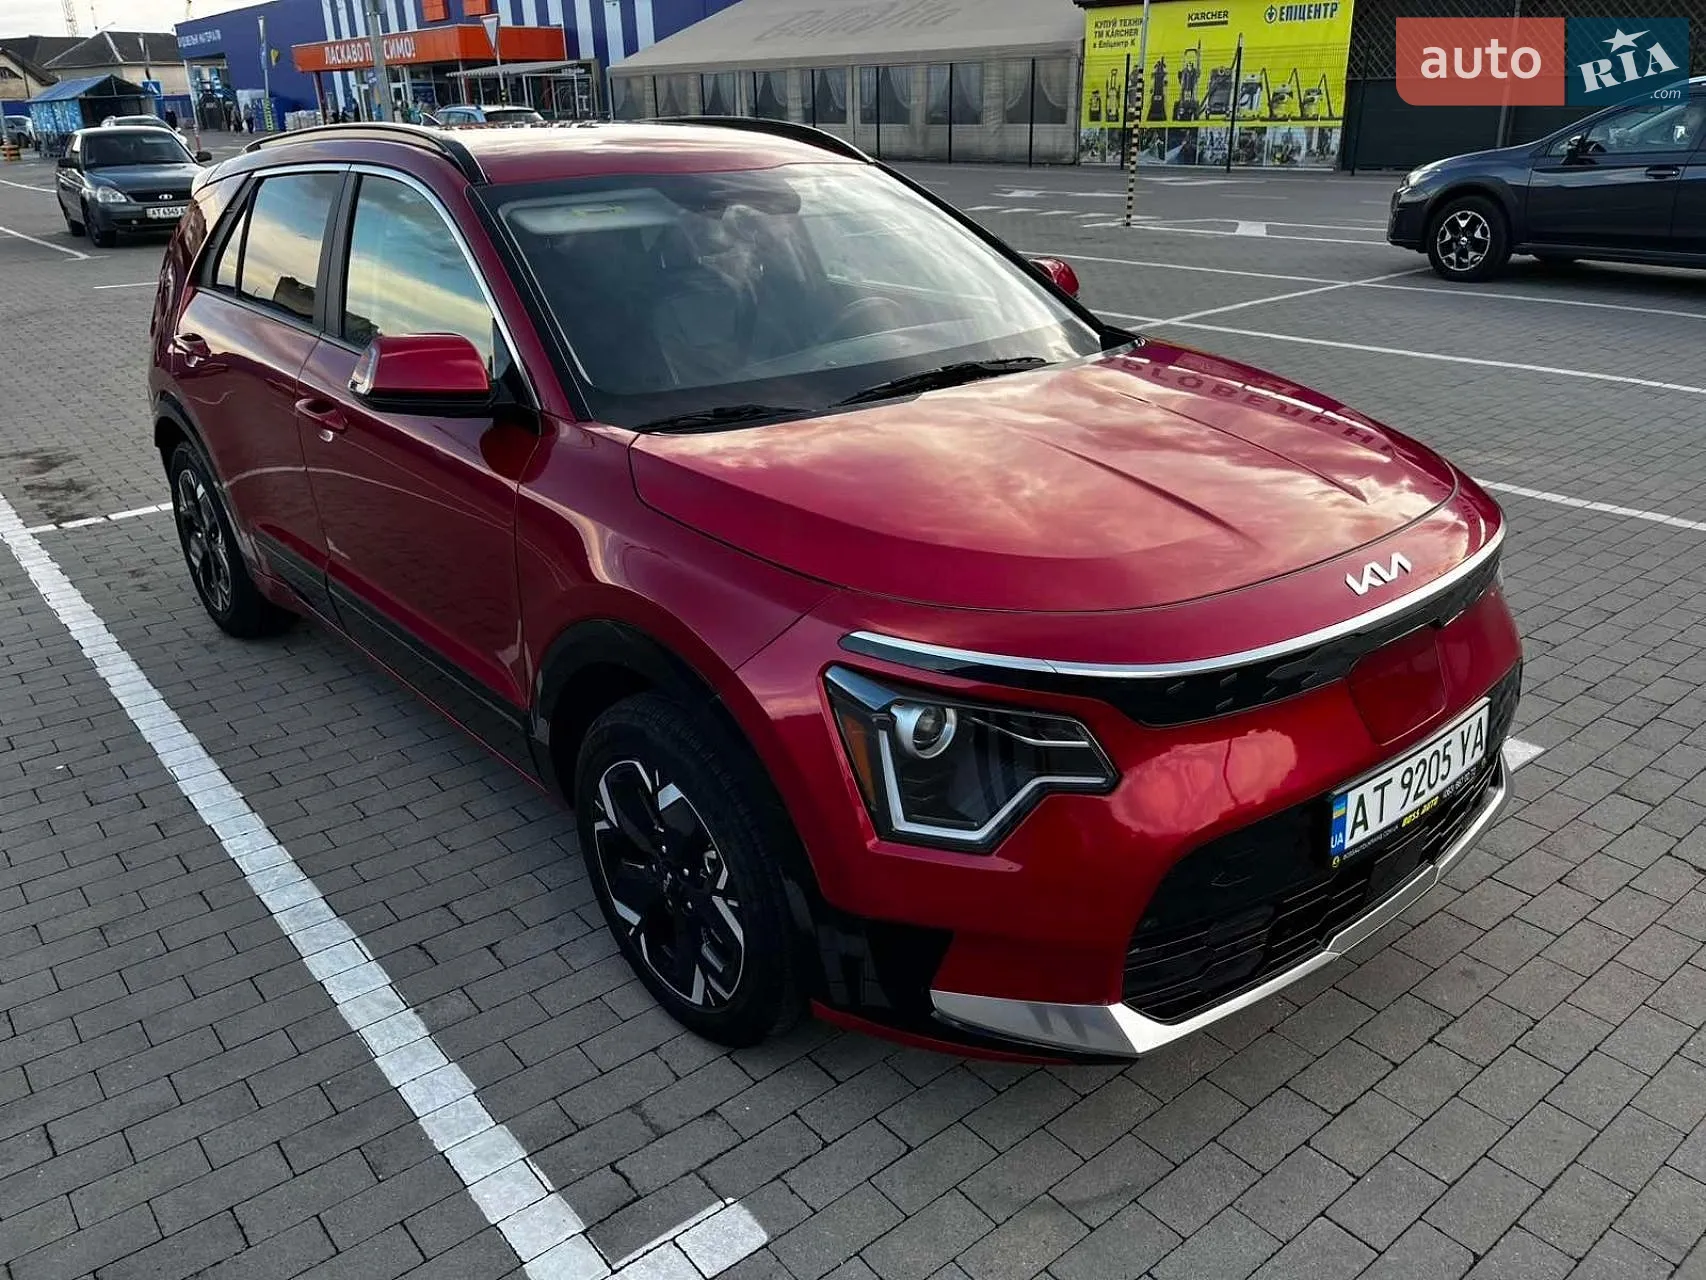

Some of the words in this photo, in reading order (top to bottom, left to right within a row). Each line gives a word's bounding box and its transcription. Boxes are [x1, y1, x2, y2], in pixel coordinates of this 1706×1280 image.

[1095, 18, 1117, 28] КУПУЙ
[1279, 2, 1338, 22] ЕПІЦЕНТР
[325, 42, 364, 64] ЛАСКАВО
[365, 36, 416, 62] ПСИМО!
[1345, 552, 1412, 595] KIA
[1348, 779, 1393, 840] AT
[1400, 739, 1452, 810] 9205
[1461, 716, 1484, 766] YA
[1330, 832, 1344, 848] UA
